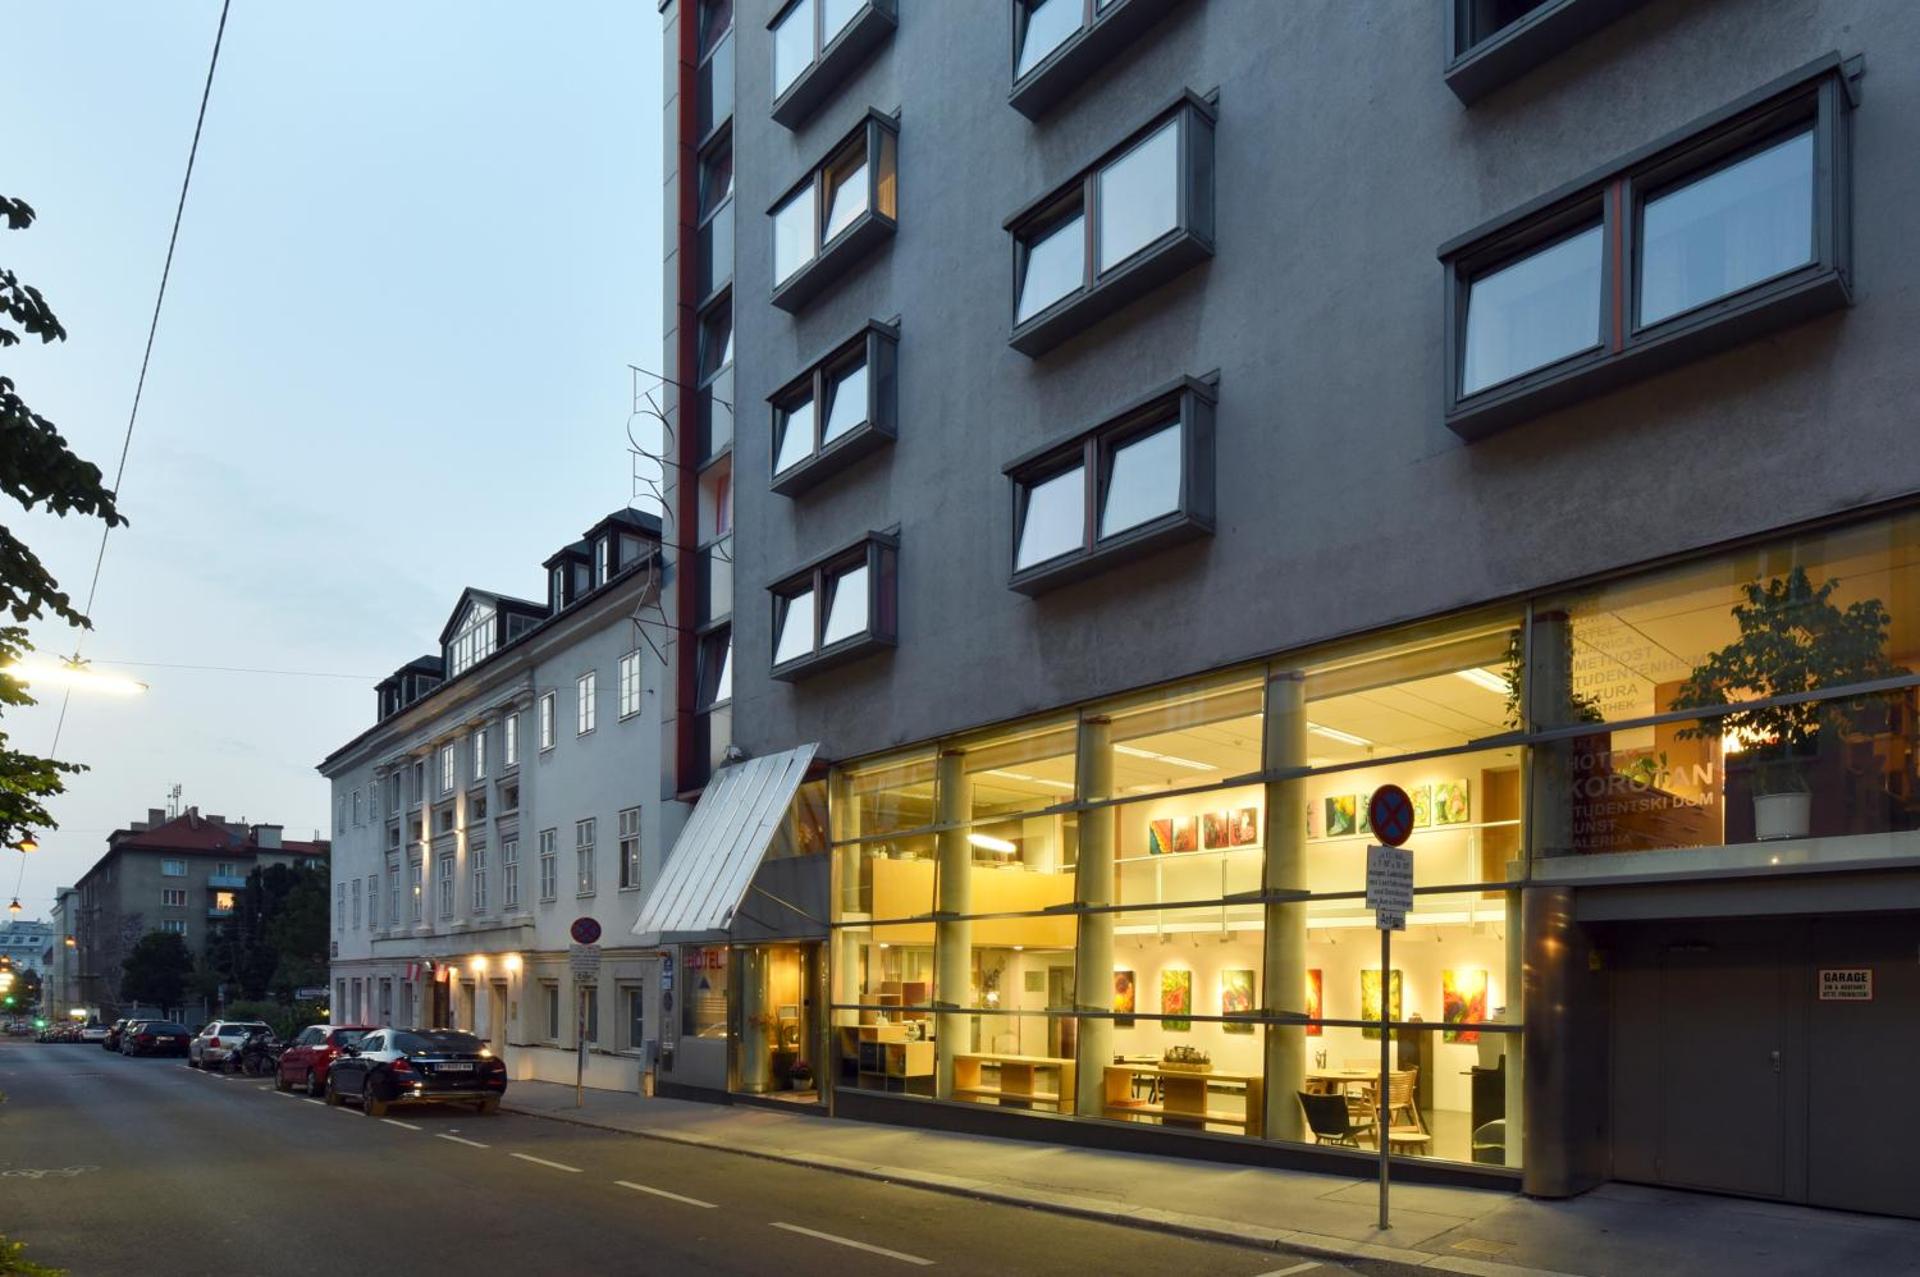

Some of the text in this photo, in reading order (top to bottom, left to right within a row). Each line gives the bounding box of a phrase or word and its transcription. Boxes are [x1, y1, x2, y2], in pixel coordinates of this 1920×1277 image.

[1574, 645, 1653, 673] METNOST
[1572, 791, 1714, 818] TUDENTSKI DOM
[1574, 818, 1616, 834] UNST
[687, 951, 722, 970] HOTEL
[1824, 972, 1867, 983] GARAGE
